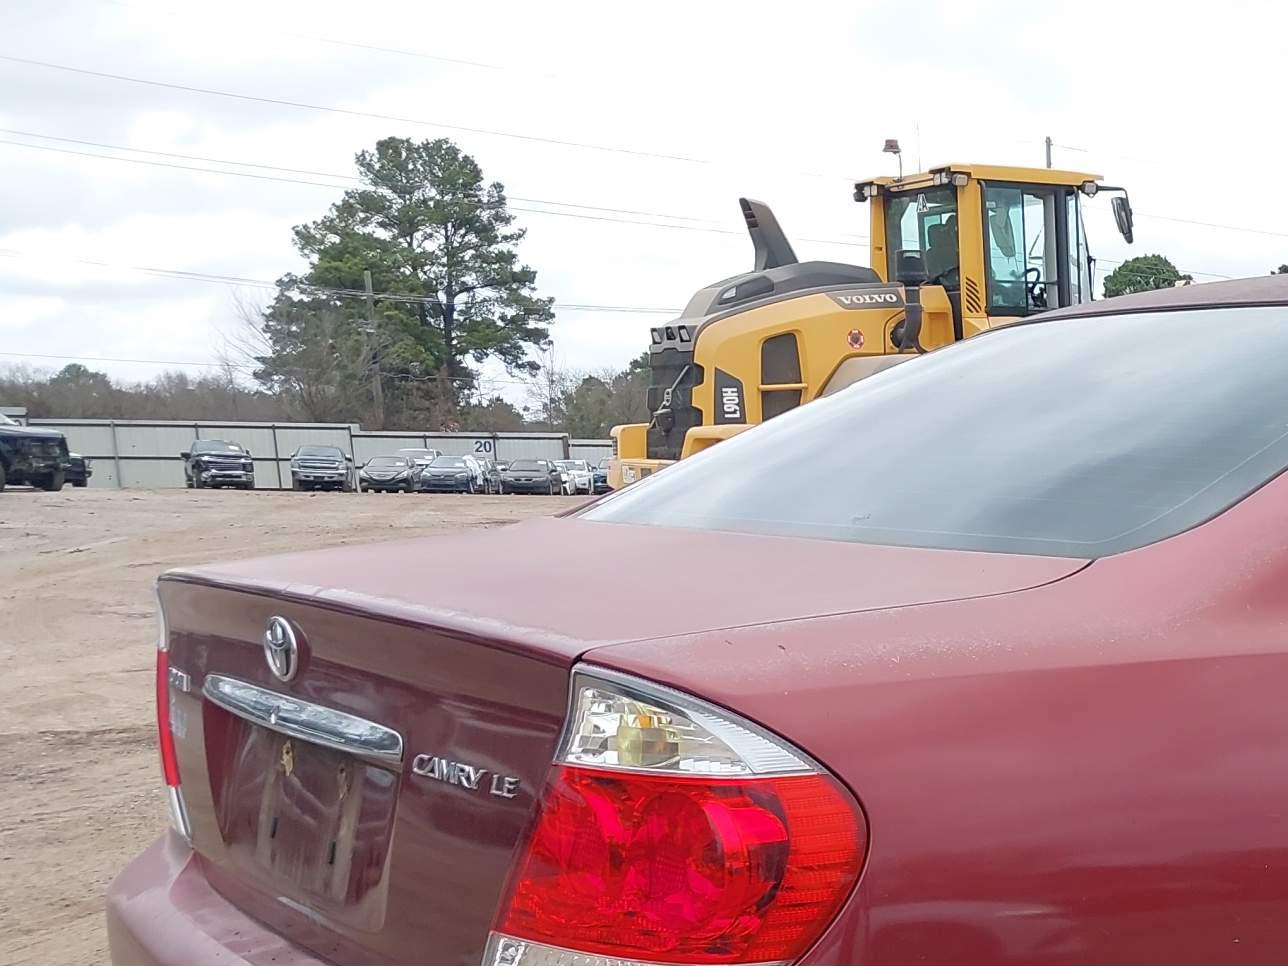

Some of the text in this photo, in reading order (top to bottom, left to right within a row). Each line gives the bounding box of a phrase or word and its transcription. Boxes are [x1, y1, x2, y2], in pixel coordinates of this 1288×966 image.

[837, 293, 898, 304] VOLVO
[722, 387, 741, 418] L90H
[474, 440, 492, 453] 20
[412, 753, 520, 799] CAMRY LE
